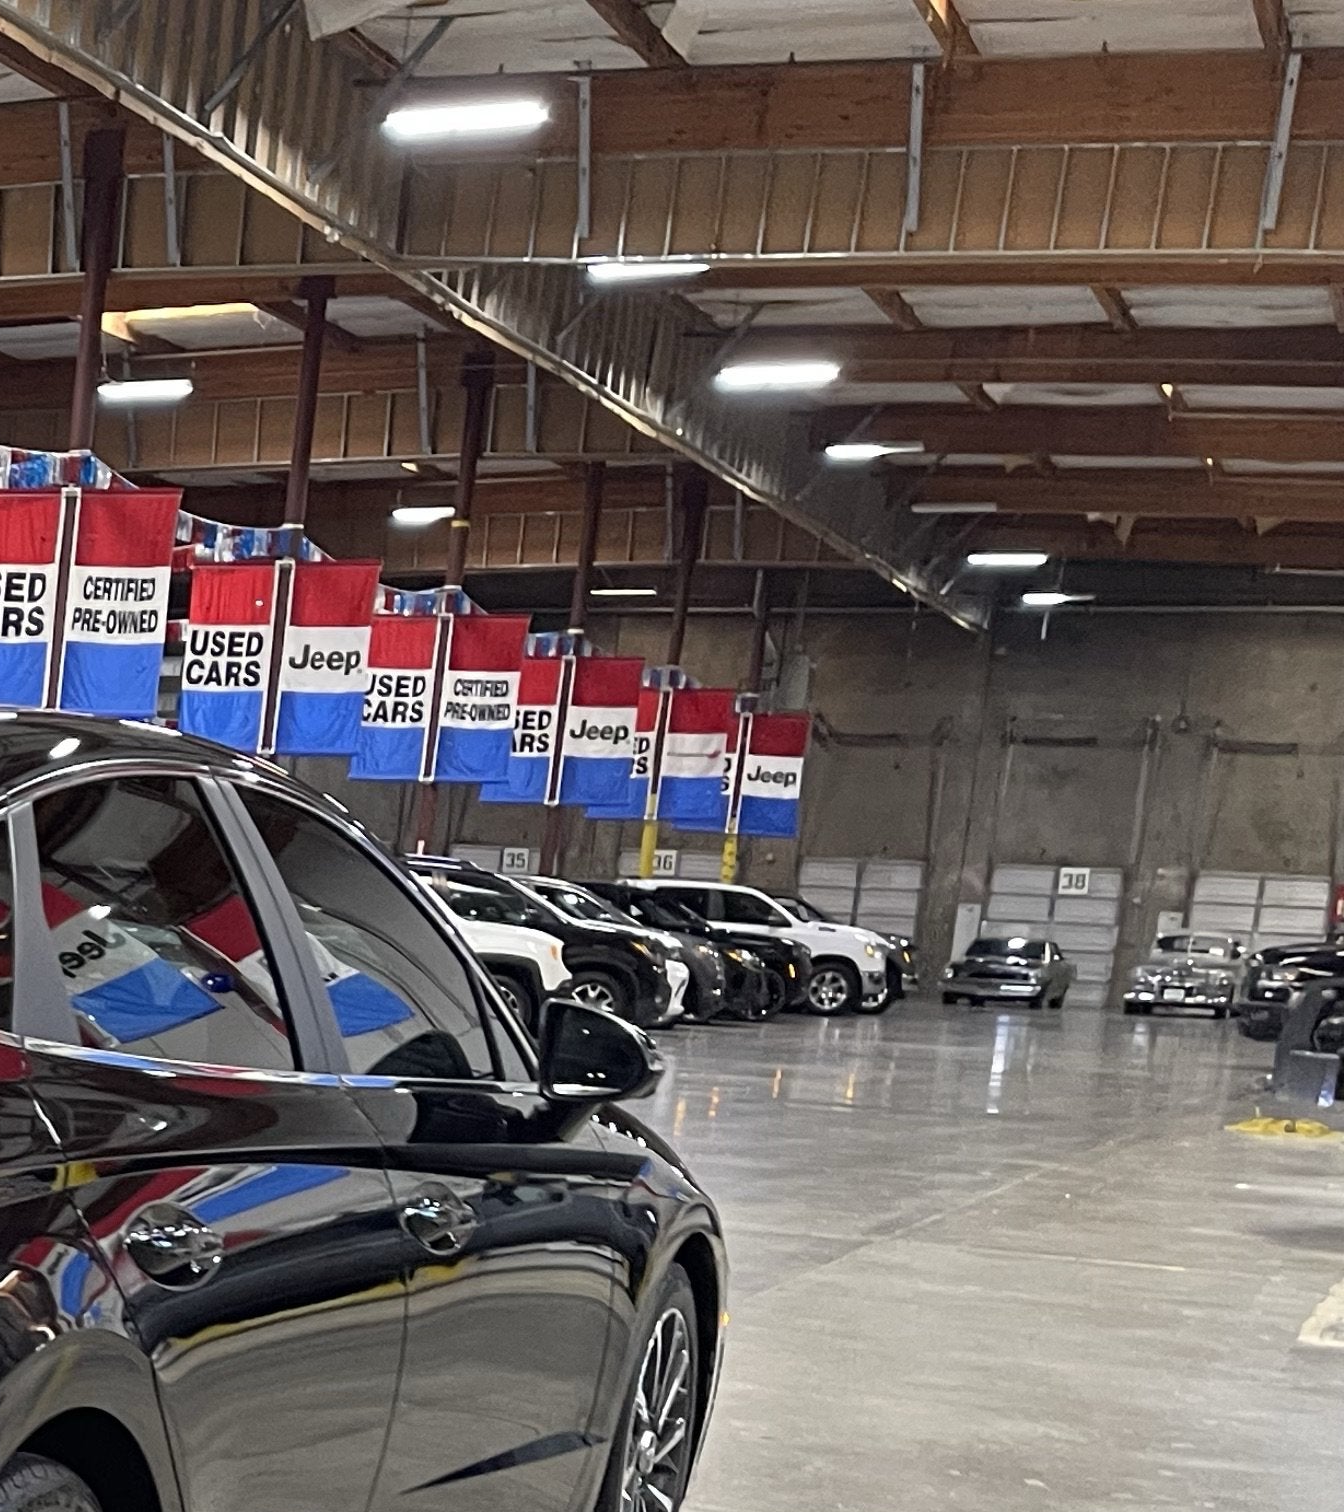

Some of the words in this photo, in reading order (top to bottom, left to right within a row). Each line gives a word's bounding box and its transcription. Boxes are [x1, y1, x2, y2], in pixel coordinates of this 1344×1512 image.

[83, 576, 156, 601] CERTIFIED
[72, 607, 159, 634] PRE-OWNED
[190, 630, 264, 658] USED
[288, 644, 361, 676] Jeep
[186, 659, 261, 687] CARS
[362, 699, 424, 722] CARS
[514, 710, 552, 730] ED
[512, 733, 550, 752] RS
[569, 719, 629, 744] Jeep
[747, 766, 797, 787] Jeep
[506, 852, 526, 868] 35
